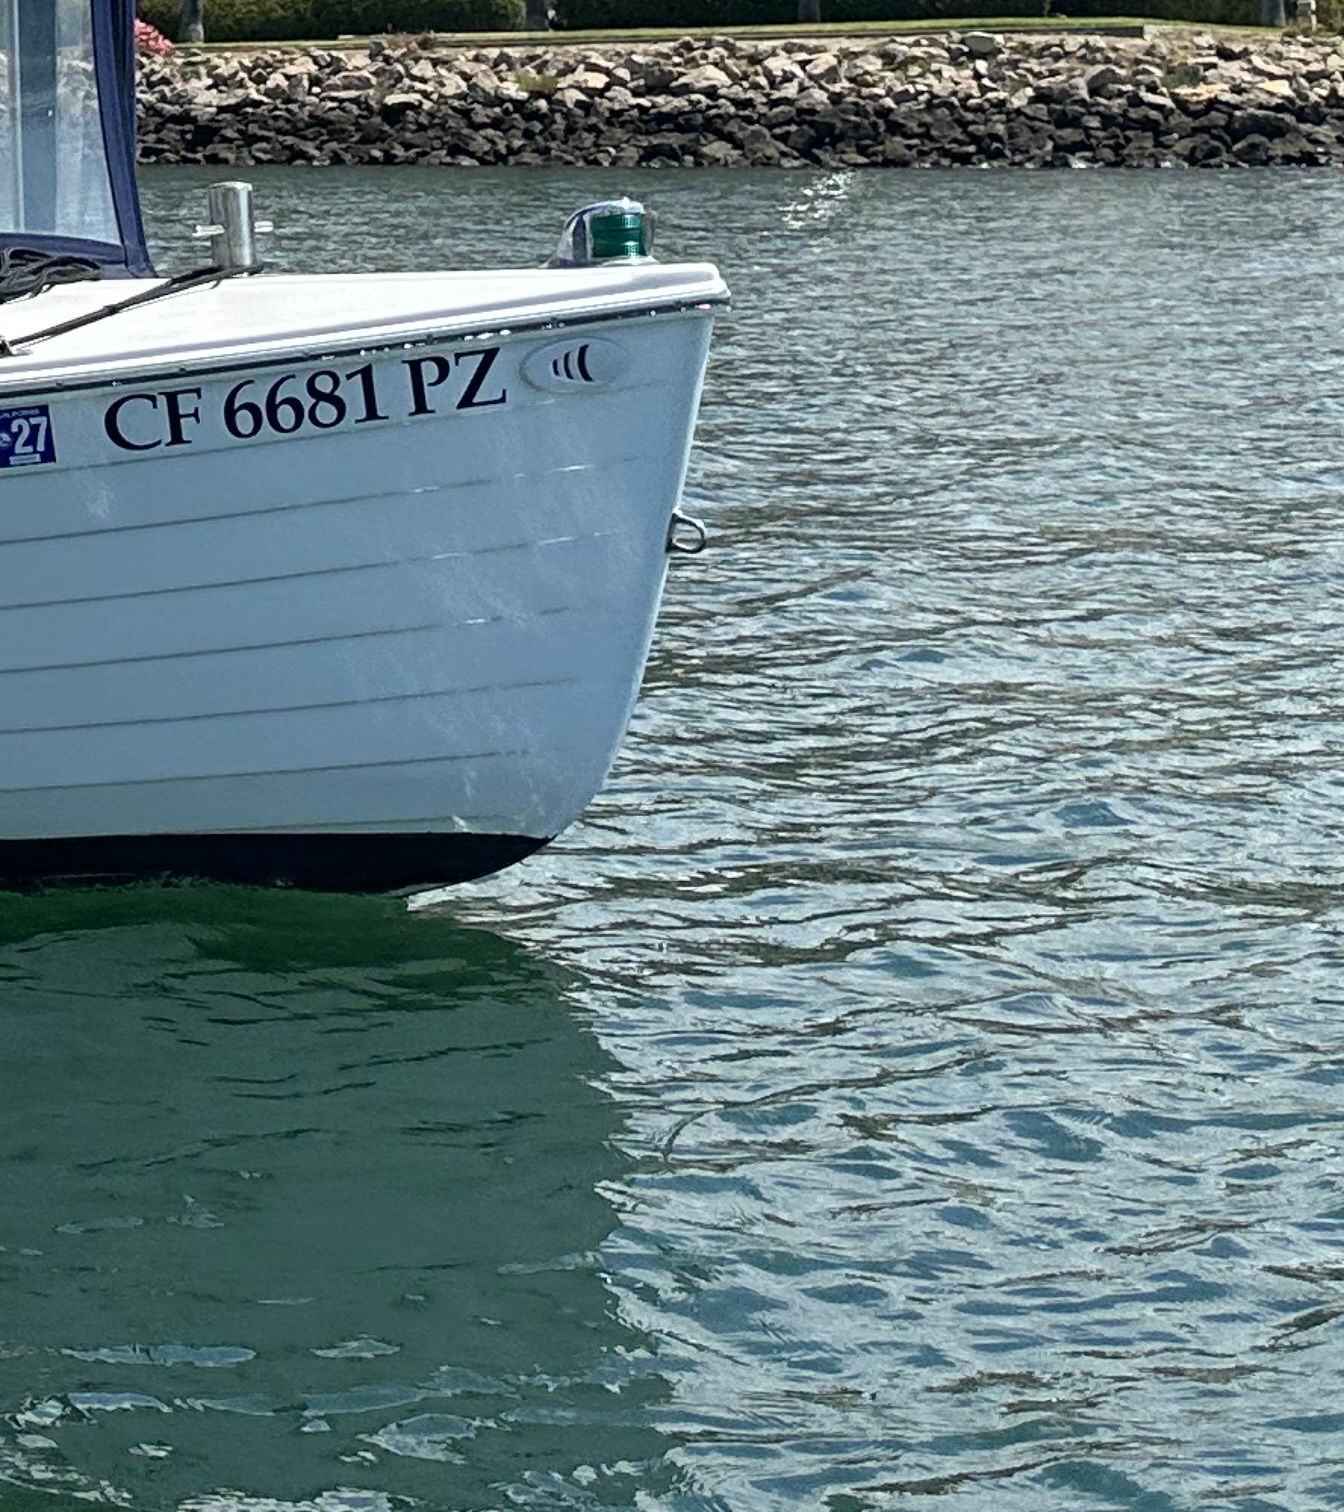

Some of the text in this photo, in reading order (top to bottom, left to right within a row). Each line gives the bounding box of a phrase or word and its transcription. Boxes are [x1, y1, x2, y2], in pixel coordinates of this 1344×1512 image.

[104, 347, 507, 451] CF 6681 PZ
[11, 416, 48, 454] 27
